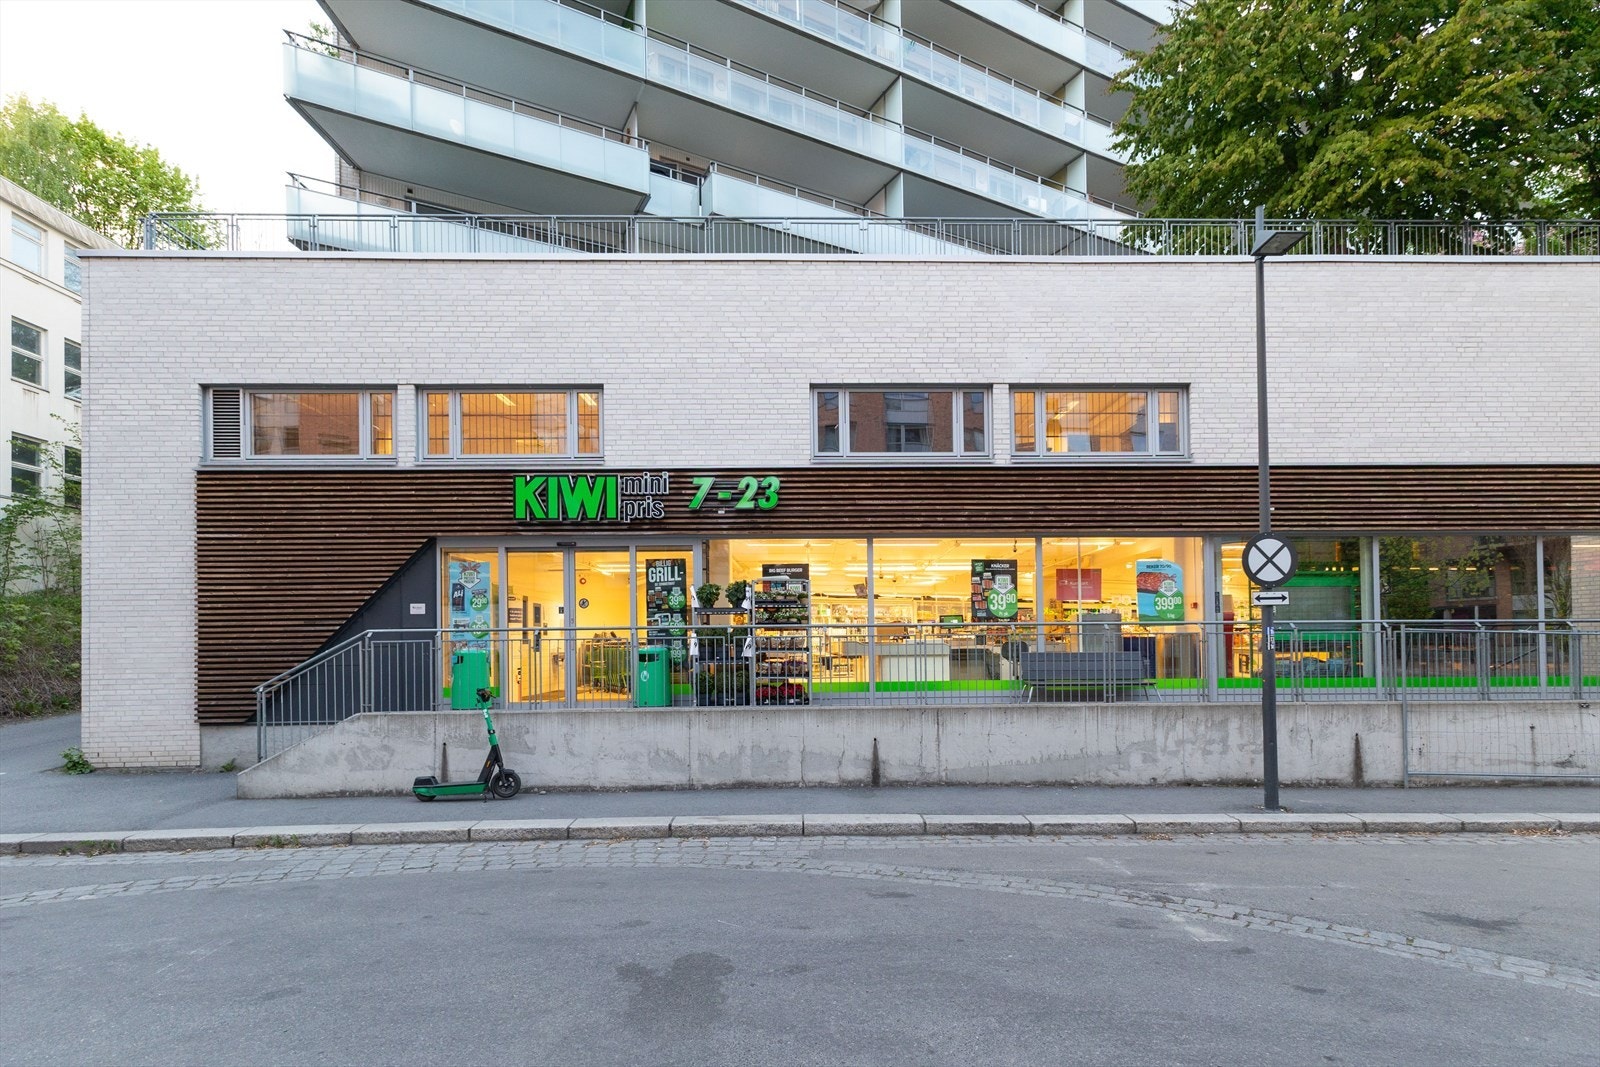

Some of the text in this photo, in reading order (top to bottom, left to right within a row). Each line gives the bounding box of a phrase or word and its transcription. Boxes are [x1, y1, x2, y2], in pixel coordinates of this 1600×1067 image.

[623, 472, 669, 495] mini
[512, 474, 620, 521] KIWI
[623, 496, 665, 522] pris
[648, 566, 683, 582] GRILL-
